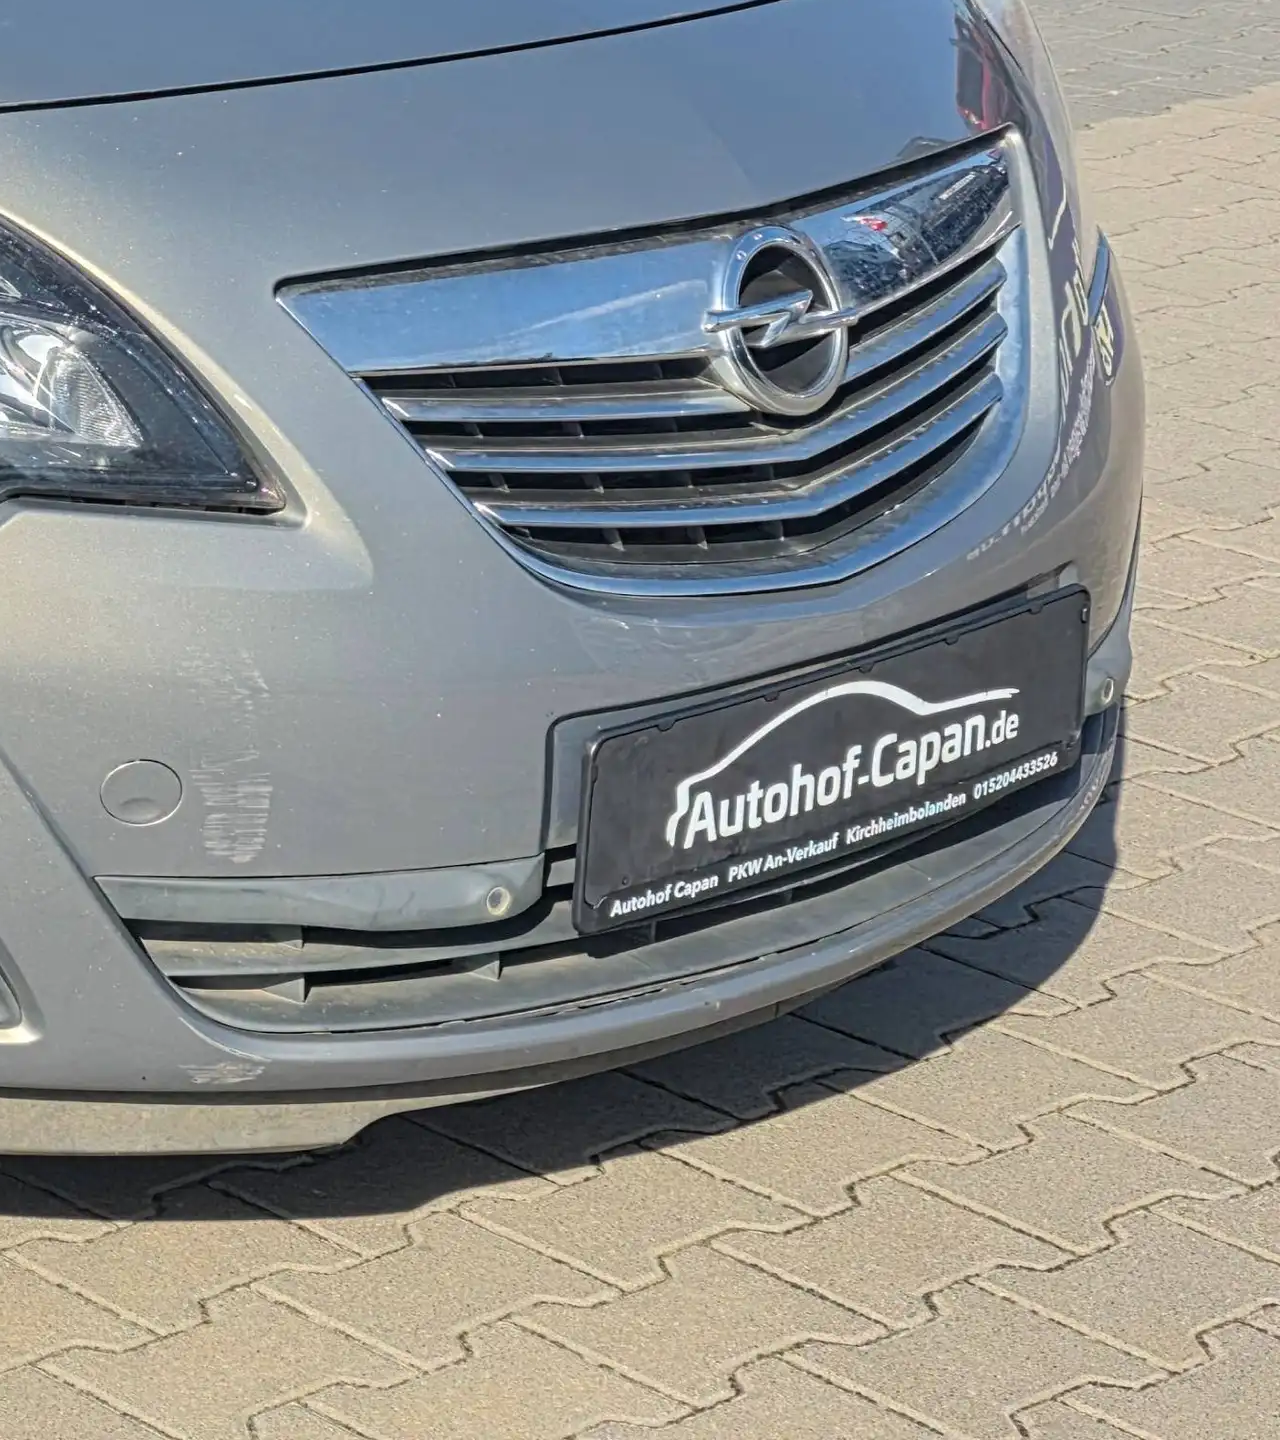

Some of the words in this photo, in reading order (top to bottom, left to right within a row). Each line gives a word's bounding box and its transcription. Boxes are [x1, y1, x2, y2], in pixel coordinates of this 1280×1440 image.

[610, 886, 672, 918] Autohof
[673, 875, 719, 898] Capan
[728, 859, 763, 883] PKW
[763, 832, 840, 872] An-Verkauf
[846, 792, 966, 845] Kirchheimbolanden
[972, 751, 1059, 800] 015204433526
[684, 710, 1020, 850] Autohof-Capan.de
